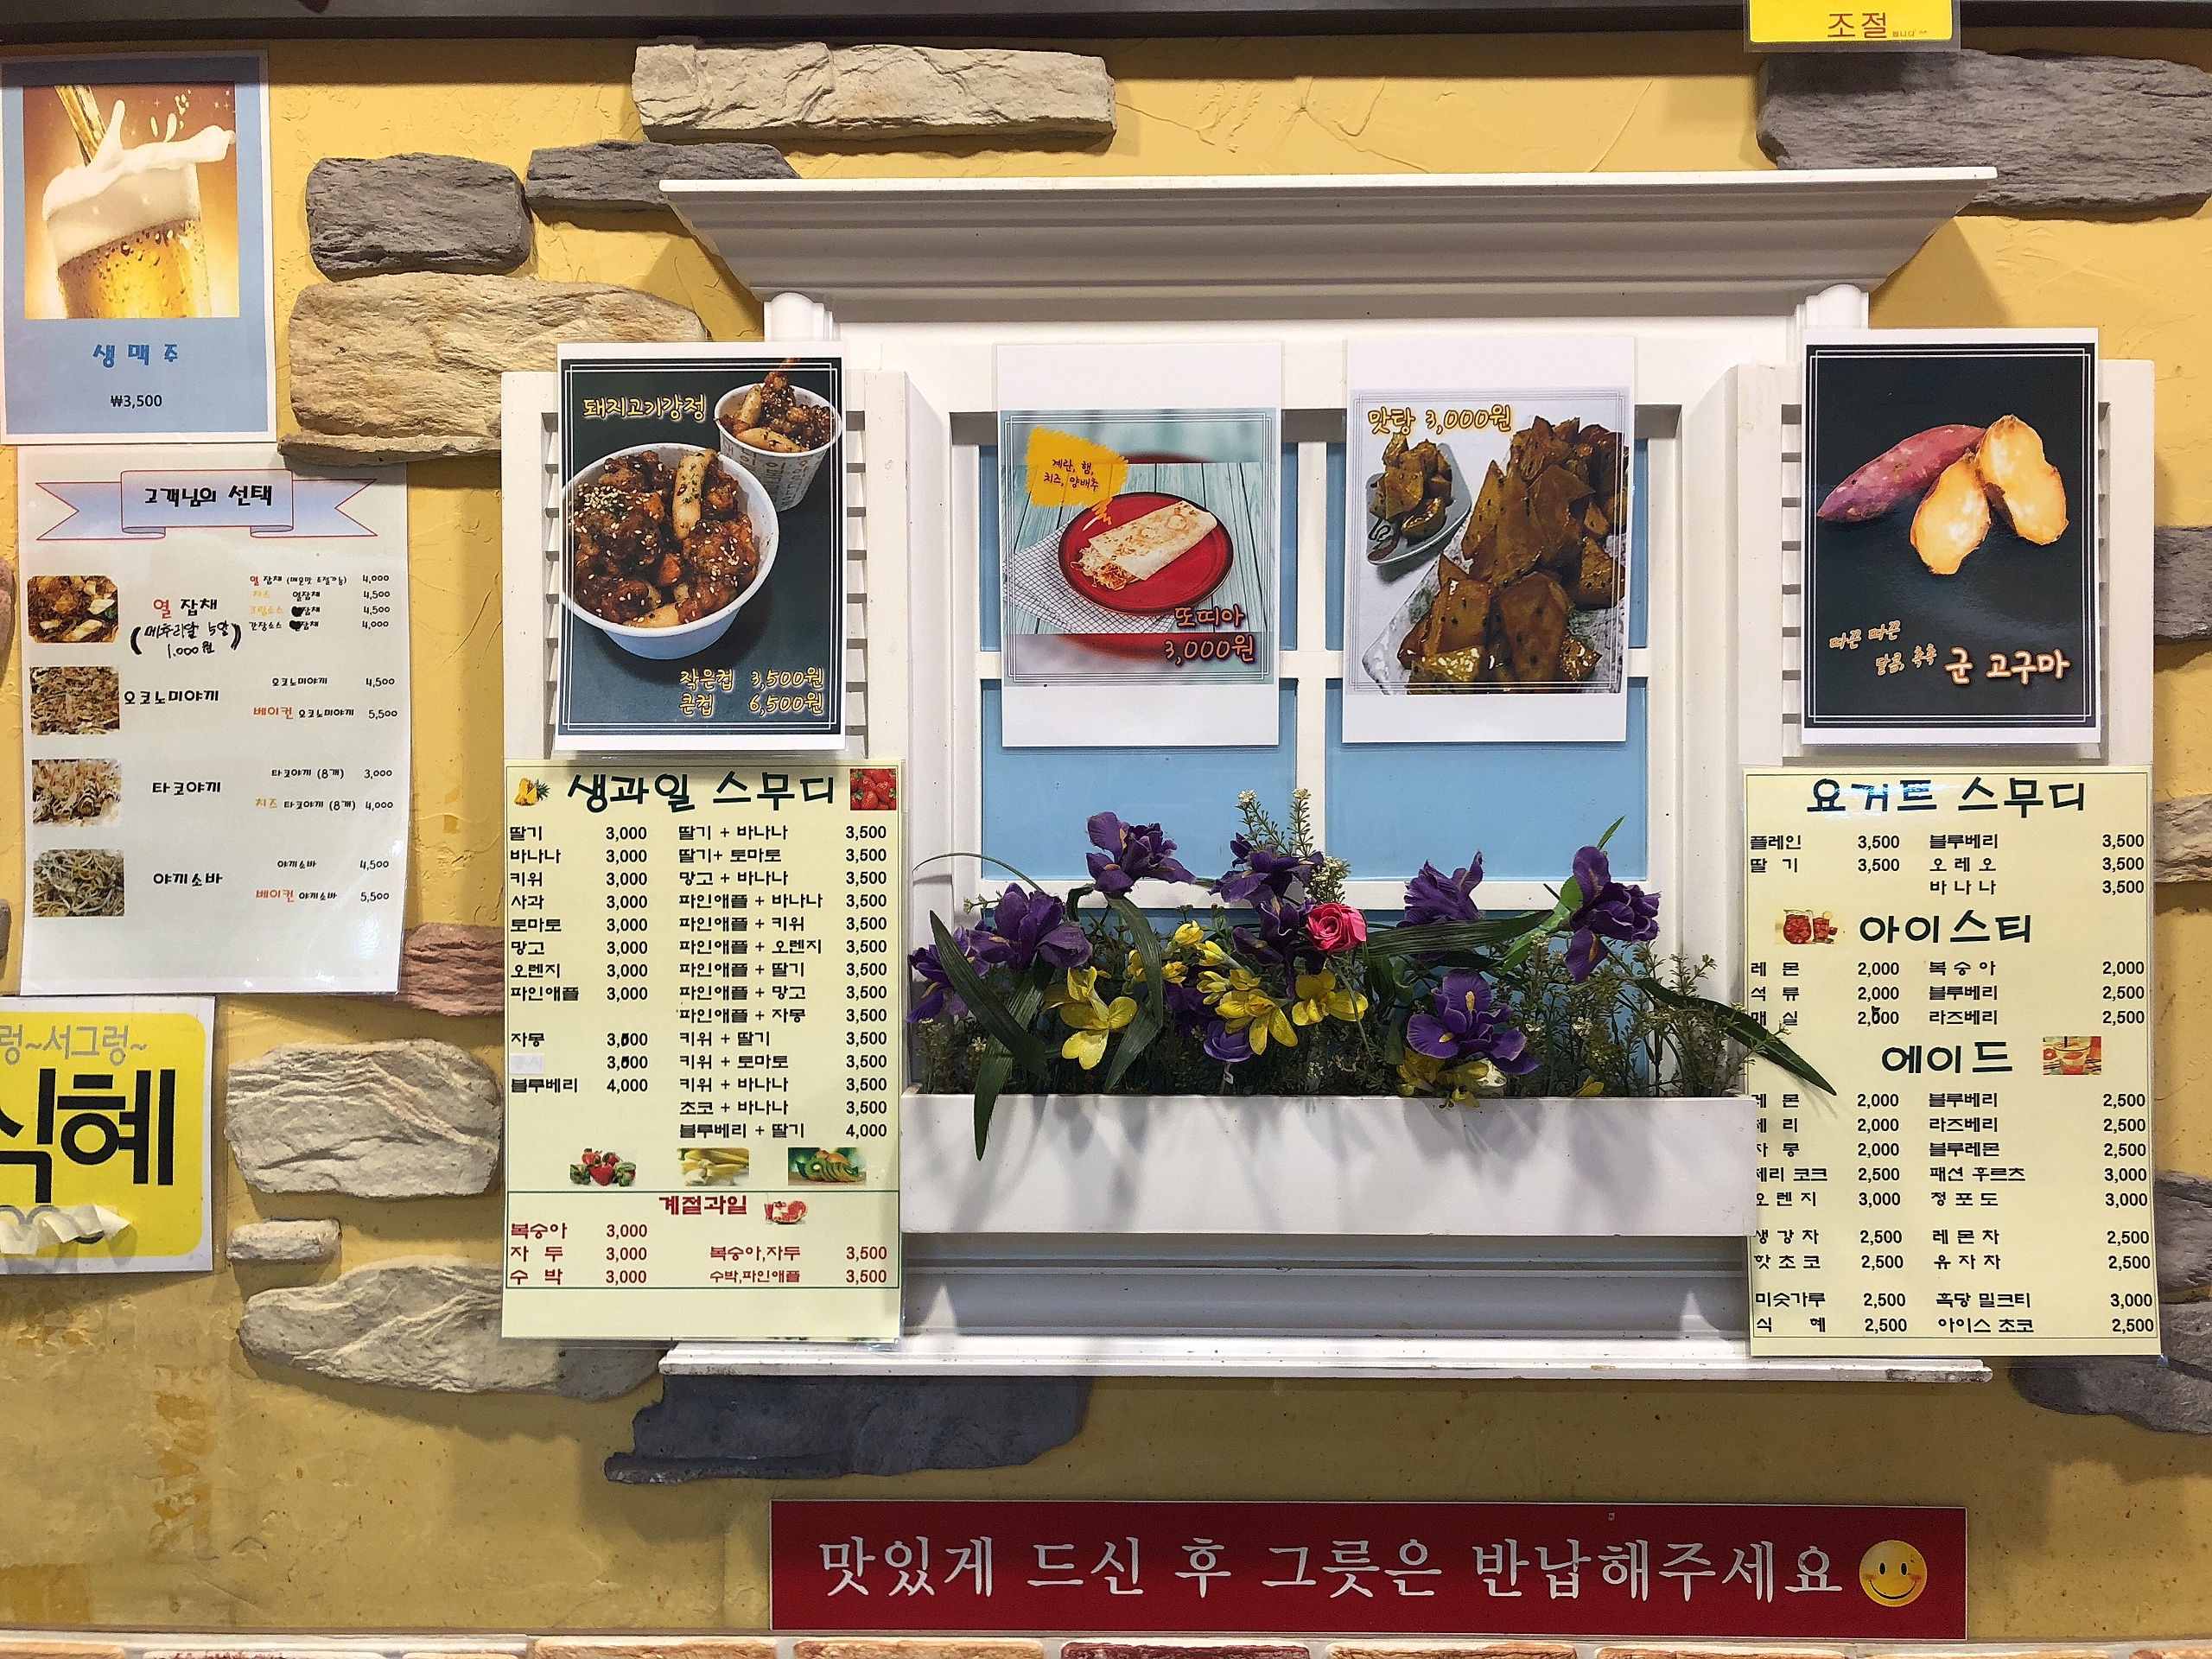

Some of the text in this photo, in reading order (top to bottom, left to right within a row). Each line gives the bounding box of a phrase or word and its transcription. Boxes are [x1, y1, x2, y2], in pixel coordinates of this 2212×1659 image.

[1825, 10, 1889, 39] 조절
[92, 343, 178, 369] 생 맥 주
[582, 393, 708, 423] 돼지고기강정
[1366, 404, 1513, 436] 맛탕 3,000원
[1052, 457, 1094, 477] 계란, 햄,
[1044, 470, 1100, 492] 치즈, 양배추
[144, 485, 272, 508] 고객님의 선택
[250, 575, 260, 587] 열
[263, 575, 283, 586] 잡채
[362, 574, 390, 584] 4,000
[292, 590, 391, 602] 열잡채 4,500
[153, 597, 218, 620] 열 잡채
[363, 605, 391, 616] 4,500
[1173, 605, 1244, 628] 또띠아
[248, 620, 390, 632] 간장소스 4,000
[1829, 620, 1901, 650] 따끈 따끈
[1164, 634, 1255, 665] 3,000원
[1912, 643, 1937, 668] 촉촉
[1944, 645, 2070, 684] 군 고구마
[271, 677, 395, 689] 오코노미야끼 4,500
[678, 666, 825, 691] 작은컵 3,500원
[124, 690, 219, 705] 오코노미야끼
[678, 693, 825, 716] 큰컵 6,500원
[253, 706, 398, 721] 베이컨 오코노미야끼 5,500
[271, 768, 393, 780] 타코야끼 (8개) 3,000
[152, 781, 221, 796] 타코야끼
[567, 770, 834, 813] 생과일 스무디
[1806, 775, 2087, 819] 요거트 스무디
[283, 800, 324, 810] 타코야끼
[328, 800, 356, 812] (8개)
[365, 801, 394, 812] 4,000
[510, 825, 647, 842] 딸기 3,000
[678, 824, 887, 842] 딸기 바나나 3,500
[1929, 833, 2145, 850] 블루베리 3,500
[1750, 835, 1900, 851] 플레인 3,500
[510, 849, 647, 866] 바나나 3,000
[678, 848, 887, 864] 딸기+ 토마토 3,500
[2102, 856, 2145, 873] 3,500
[276, 860, 390, 872] 야끼소바 4,500
[153, 873, 224, 887] 야끼소바
[255, 889, 390, 903] 베이컨 야끼소바 5,500
[511, 894, 648, 912] 사과 3,000
[678, 893, 887, 910] 파인애플 바나나 3,500
[1859, 909, 2031, 944] 아이스티
[511, 940, 648, 957] 망고 3,000
[679, 938, 887, 956] 파인애플 오렌지 3,500
[2102, 961, 2145, 977] 2,000
[510, 986, 648, 1003] 파인애플 3,000
[679, 984, 887, 1001] 파인애플 망고 3,500
[1929, 984, 2145, 1002] 블루베리 2,500
[1929, 1009, 2145, 1027] 라즈베리 2,500
[511, 1032, 545, 1048] 자몽
[679, 1031, 887, 1047] 키위 딸기 3,500
[1881, 1041, 2013, 1074] 에이드
[511, 1077, 648, 1095] 블루베리 4,000
[679, 1077, 887, 1094] 키위 바나나 3,500
[1929, 1092, 2146, 1109] 블루베리 2,500
[679, 1122, 887, 1140] 블루베리 딸기 4,000
[1929, 1116, 2146, 1135] 라즈베리 2,500
[1857, 1142, 1900, 1159] 2,000
[1929, 1141, 2146, 1160] 블루레몬 2,500
[1792, 1167, 1900, 1184] 코크 2,500
[1929, 1166, 2147, 1184] 패션 후르츠 3,000
[658, 1194, 747, 1216] 계절과일
[511, 1222, 648, 1240] 복숭아 3,000
[2107, 1230, 2150, 1247] 2,500
[606, 1246, 647, 1263] 3,000
[709, 1245, 887, 1262] 복숭아,자두 3,500
[606, 1269, 647, 1286] 3,000
[709, 1268, 887, 1286] 수박,파인애플 3,500
[1755, 1291, 1906, 1309] 미숫가루 2,500
[1936, 1292, 2153, 1310] 흑당 밀크티 3,000
[1864, 1318, 1908, 1334] 2,500
[1937, 1317, 2154, 1335] 아이스 초코 2,500
[818, 1530, 1846, 1607] 맛있게 드신 후 그릇은 반납해주세요
